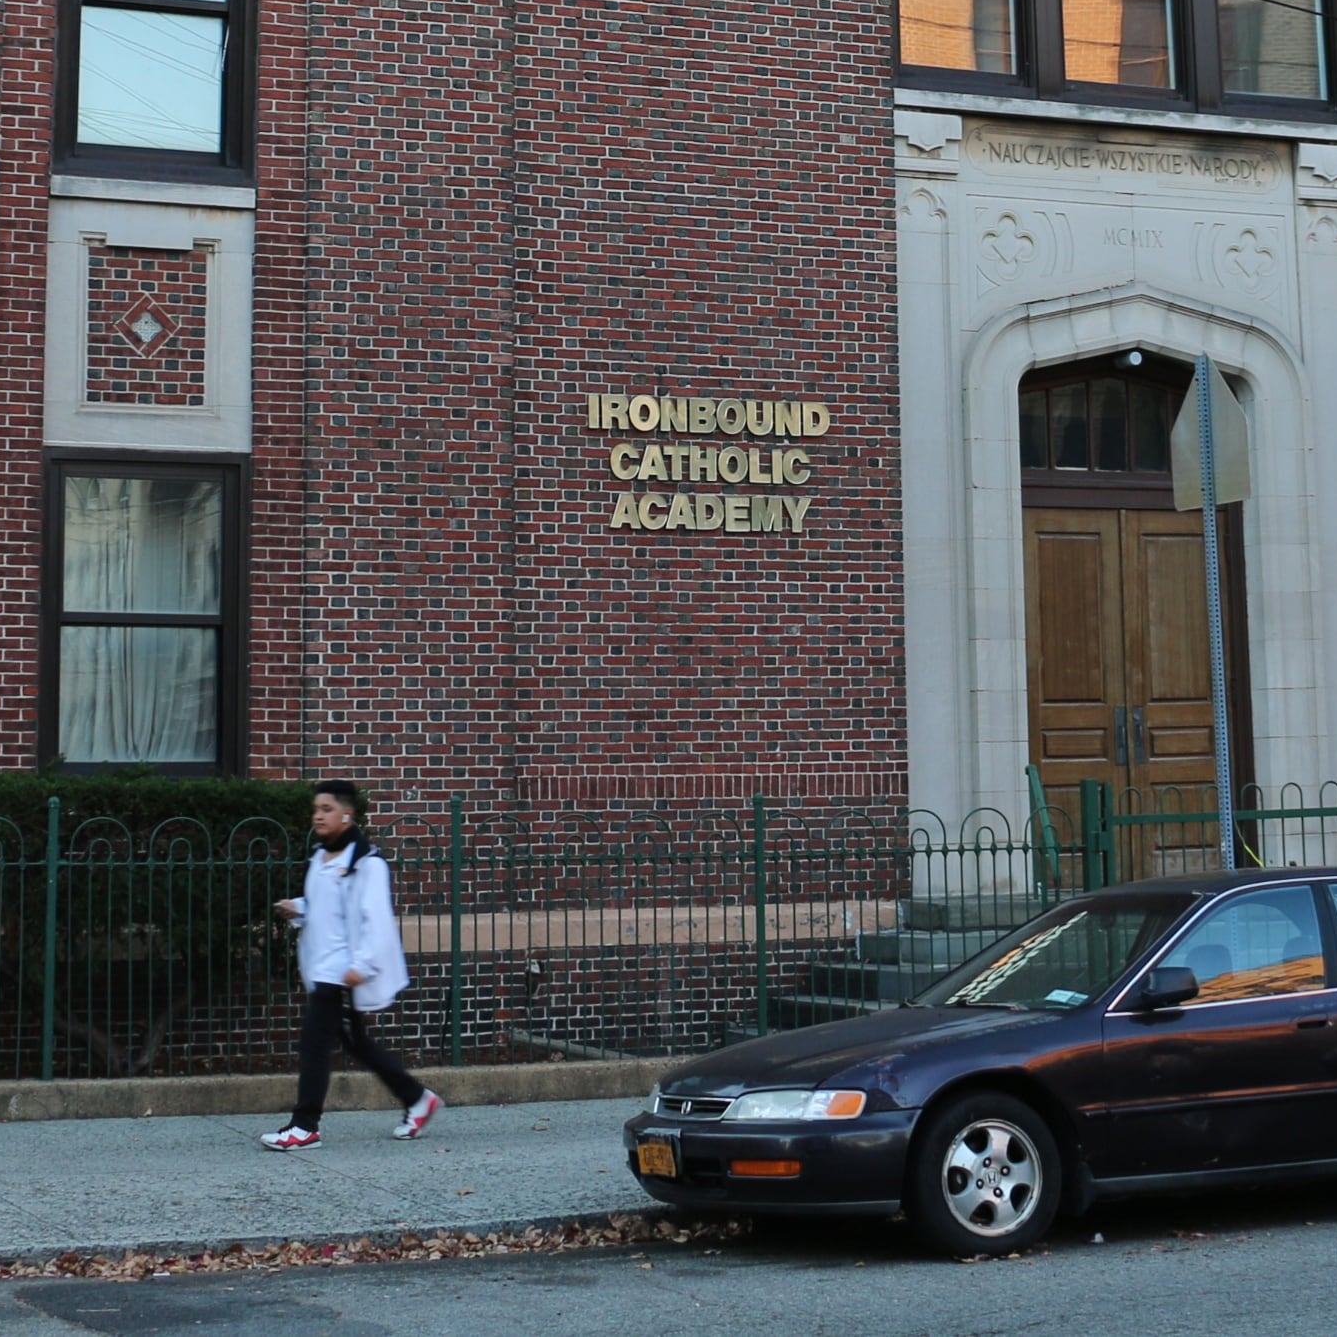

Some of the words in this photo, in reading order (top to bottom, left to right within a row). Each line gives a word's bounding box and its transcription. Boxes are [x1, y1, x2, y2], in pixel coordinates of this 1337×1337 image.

[988, 142, 1091, 170] NAUCZAJCIE
[1096, 149, 1183, 174] WSZYSTKIE
[1189, 155, 1260, 180] NARODY
[587, 393, 830, 437] IRONBOUND
[610, 443, 811, 485] CATHOLIC
[610, 492, 811, 534] ACADEMY
